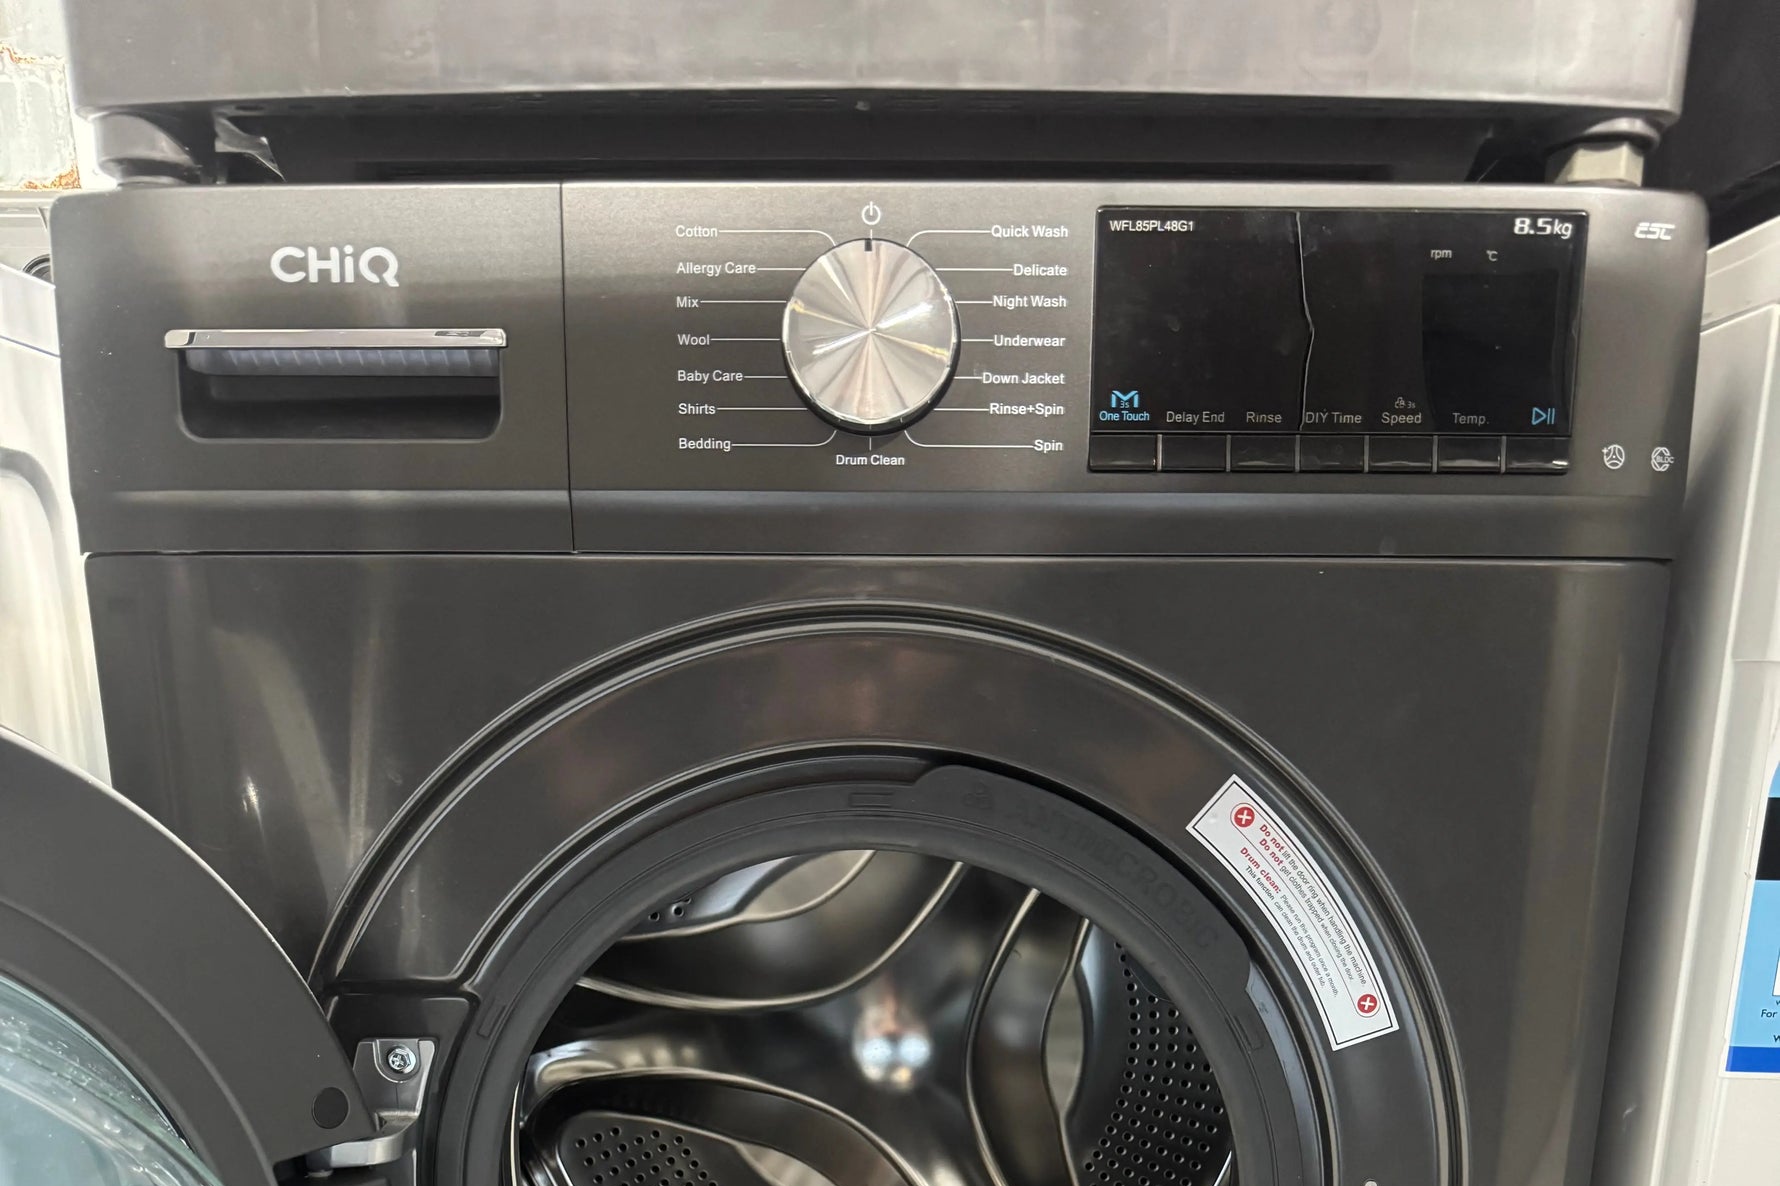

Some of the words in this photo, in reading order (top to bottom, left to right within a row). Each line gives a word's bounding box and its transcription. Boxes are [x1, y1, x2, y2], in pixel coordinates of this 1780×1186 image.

[676, 225, 718, 238] Cotton
[991, 225, 1029, 238] Quick
[1031, 225, 1068, 238] Wash
[1109, 220, 1194, 232] WFL85PL48G1
[1514, 218, 1572, 238] 8.5kg
[1430, 250, 1452, 260] rpm
[270, 244, 400, 287] CHiQ
[676, 262, 720, 276] Allergy
[725, 262, 756, 275] Care
[1013, 264, 1067, 276] Delicate
[676, 296, 699, 308] Mix
[993, 295, 1028, 310] Night
[1030, 296, 1066, 308] Wash
[678, 334, 710, 346] Wool
[994, 334, 1065, 347] Underwear
[677, 370, 709, 384] Baby
[712, 370, 743, 382] Care
[982, 372, 1018, 384] Down
[1021, 372, 1064, 384] Jacket
[678, 402, 716, 414] Shirts
[989, 403, 1064, 416] Rinse+Spin
[1099, 411, 1122, 421] One
[1122, 410, 1150, 421] Touch
[1166, 412, 1200, 424] Delay
[1202, 412, 1225, 423] End
[1246, 412, 1282, 423] Rinse
[1305, 412, 1328, 423] DIY
[1332, 412, 1362, 424] Time
[1382, 412, 1422, 426] Speed
[1452, 412, 1490, 426] Temp.
[678, 438, 731, 452] Bedding
[1034, 439, 1064, 452] Spin
[836, 454, 867, 466] Drum
[870, 454, 905, 466] Clean
[1260, 824, 1271, 837] Do
[1270, 837, 1285, 853] not
[1282, 850, 1292, 860] lift
[1288, 859, 1298, 870] the
[1296, 870, 1310, 884] door
[1307, 884, 1319, 899] ring
[1316, 899, 1330, 917] when
[1328, 915, 1347, 945] handling
[1344, 944, 1353, 956] the
[1240, 847, 1260, 869] Drum
[1260, 869, 1281, 894] clean:
[1280, 894, 1295, 914] Please
[1294, 914, 1302, 924] run
[1300, 922, 1308, 934] this
[1306, 934, 1320, 958] program
[1318, 958, 1328, 972] once
[1260, 838, 1270, 851] Do
[1270, 851, 1284, 866] not
[1280, 864, 1292, 877] get
[1288, 876, 1308, 899] clothes
[1304, 897, 1324, 923] trapped
[1320, 922, 1332, 939] when
[1340, 957, 1348, 968] the
[1246, 864, 1256, 879] This
[1256, 878, 1275, 901] function
[1274, 900, 1284, 912] can
[1282, 911, 1293, 927] clean
[1291, 926, 1299, 936] the
[1305, 950, 1314, 961] and
[1311, 961, 1321, 976] outer
[1761, 1008, 1778, 1018] For
